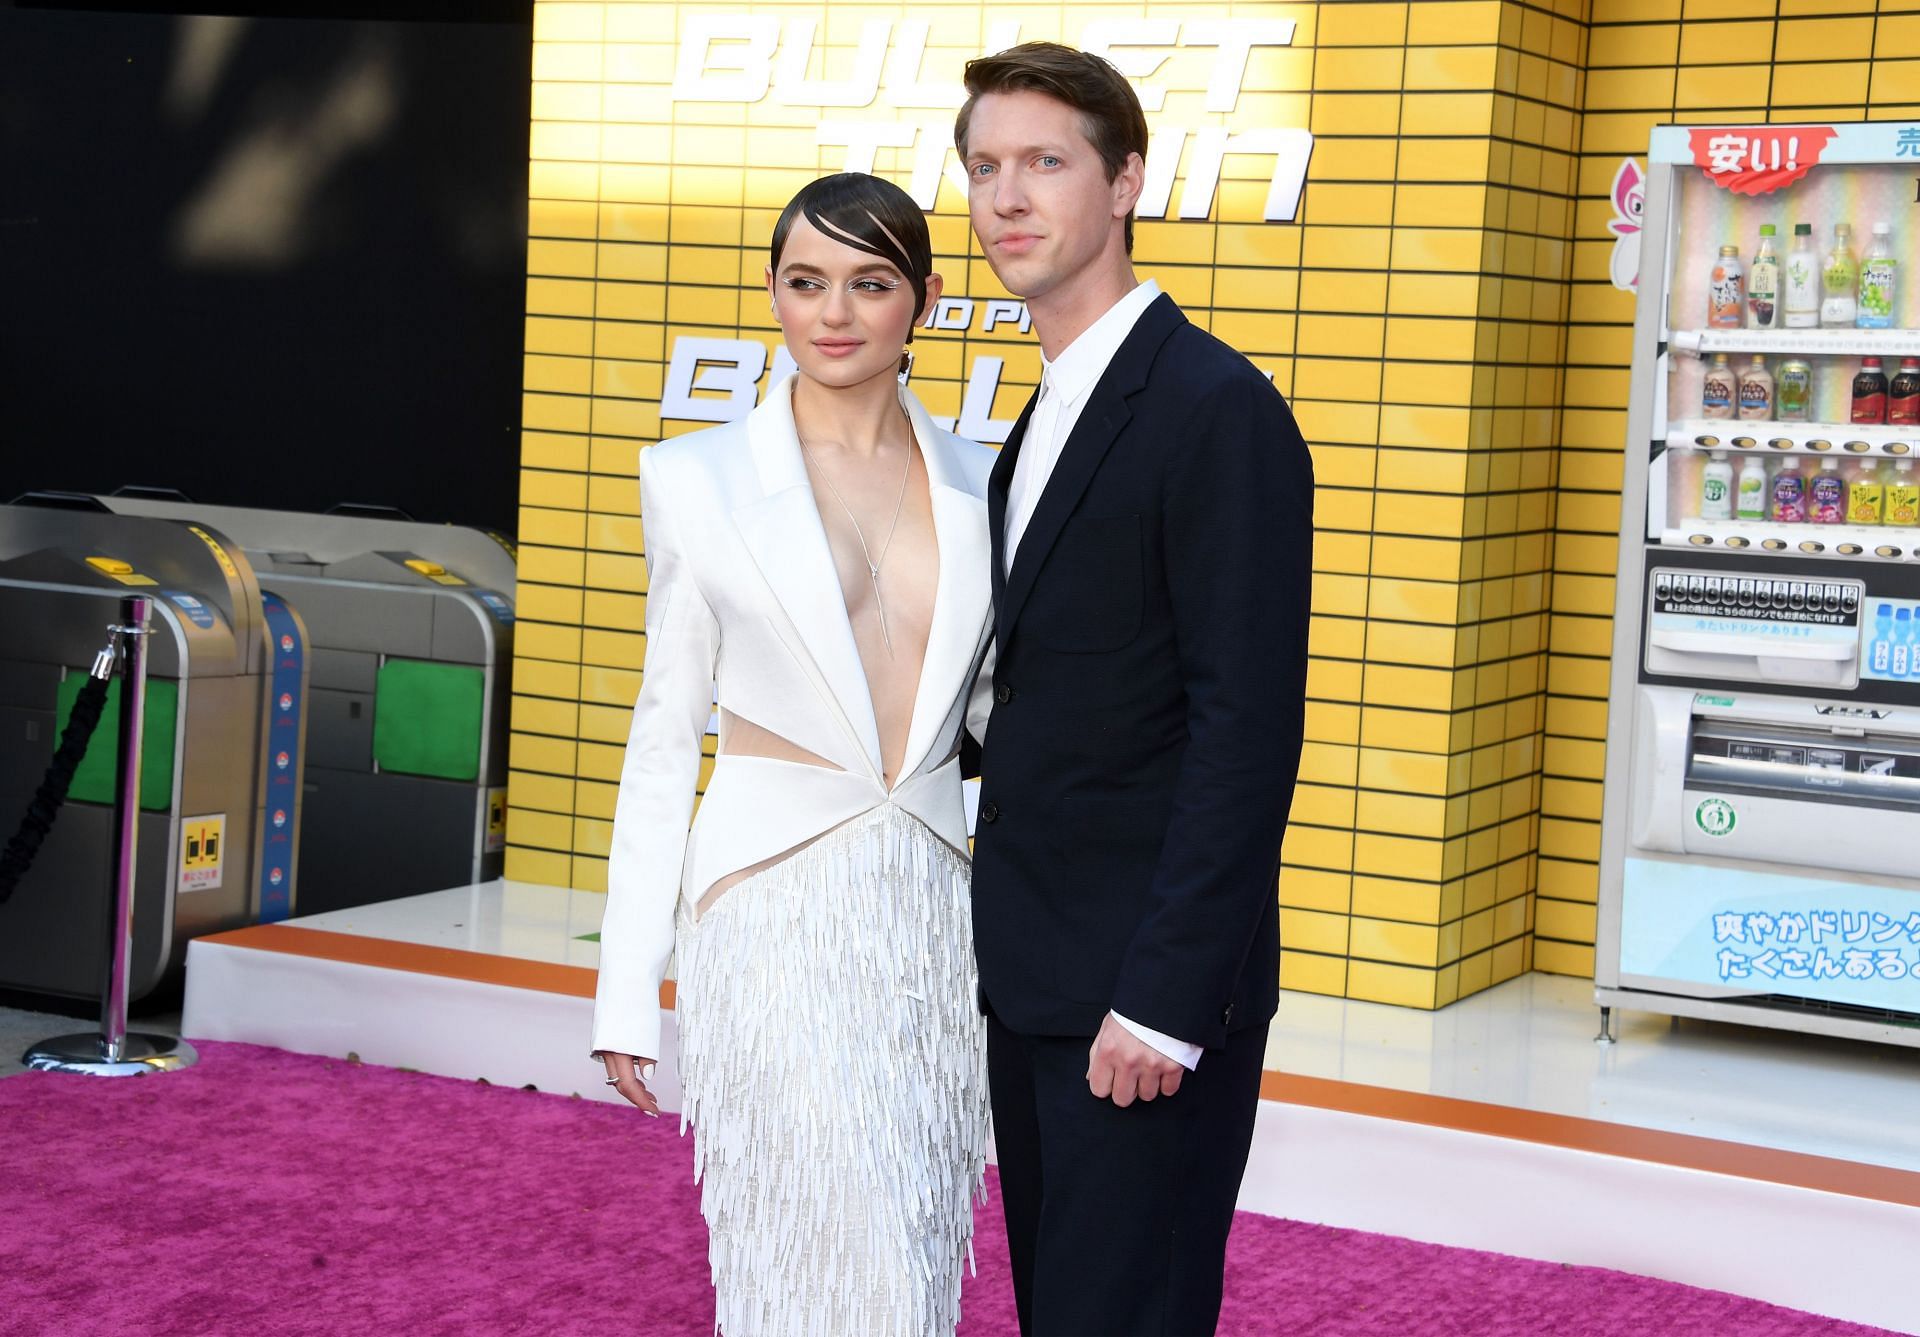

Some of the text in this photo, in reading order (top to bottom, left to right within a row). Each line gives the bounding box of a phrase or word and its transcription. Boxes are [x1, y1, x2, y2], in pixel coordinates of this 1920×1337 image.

[1707, 133, 1799, 174] 安い!
[1662, 575, 1856, 596] 1 2 3 4 5 6 7 8 9 10 11 12
